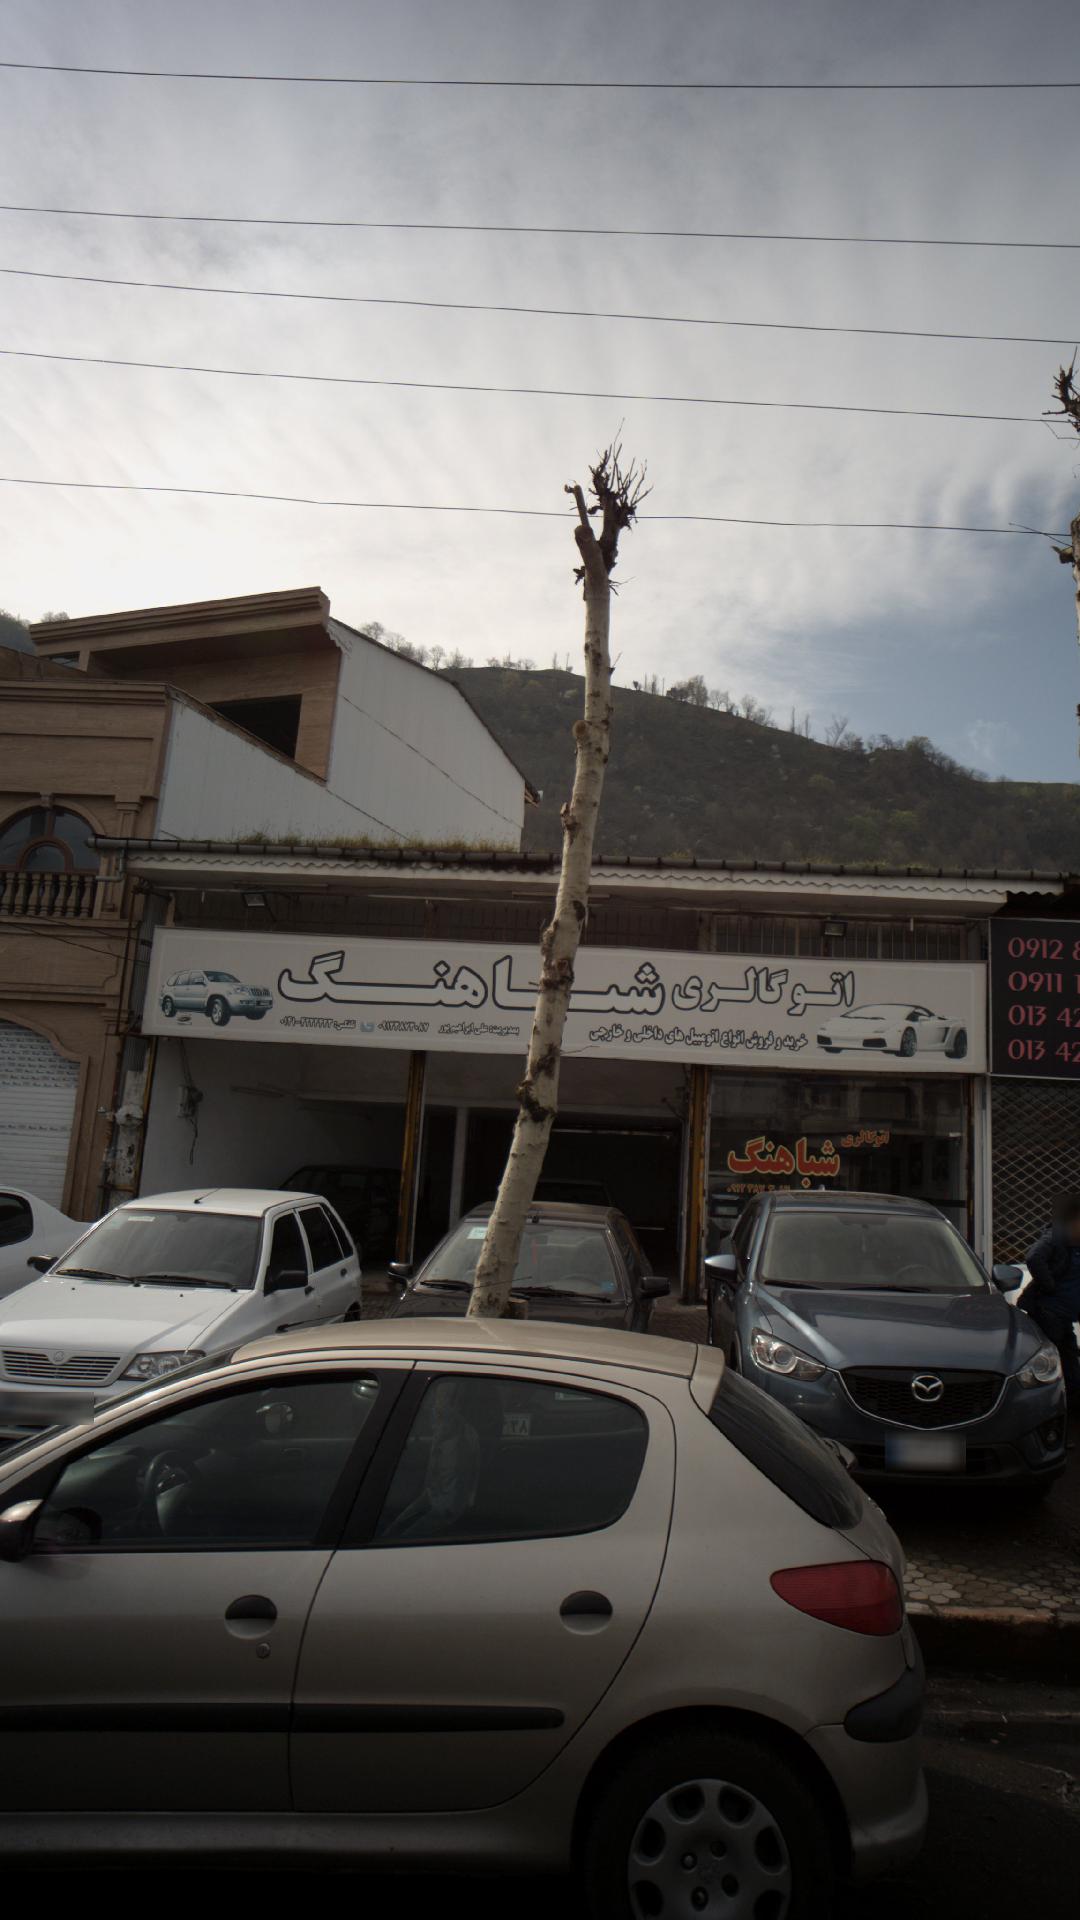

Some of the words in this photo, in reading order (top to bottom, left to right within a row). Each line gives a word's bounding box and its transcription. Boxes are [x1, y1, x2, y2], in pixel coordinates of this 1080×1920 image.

[1008, 937, 1064, 960] 0912
[278, 950, 665, 1016] شاهنگ
[1008, 971, 1063, 993] 0911
[1008, 1004, 1047, 1026] 013
[589, 1023, 624, 1042] خارجی
[625, 1029, 632, 1042] و
[633, 1025, 664, 1043] داخلی
[720, 1029, 746, 1048] انواع
[746, 1030, 774, 1050] فروش
[783, 1033, 809, 1051] خرید
[774, 1036, 782, 1050] و
[1008, 1039, 1046, 1060] 013
[727, 1135, 841, 1188] شباهنگ
